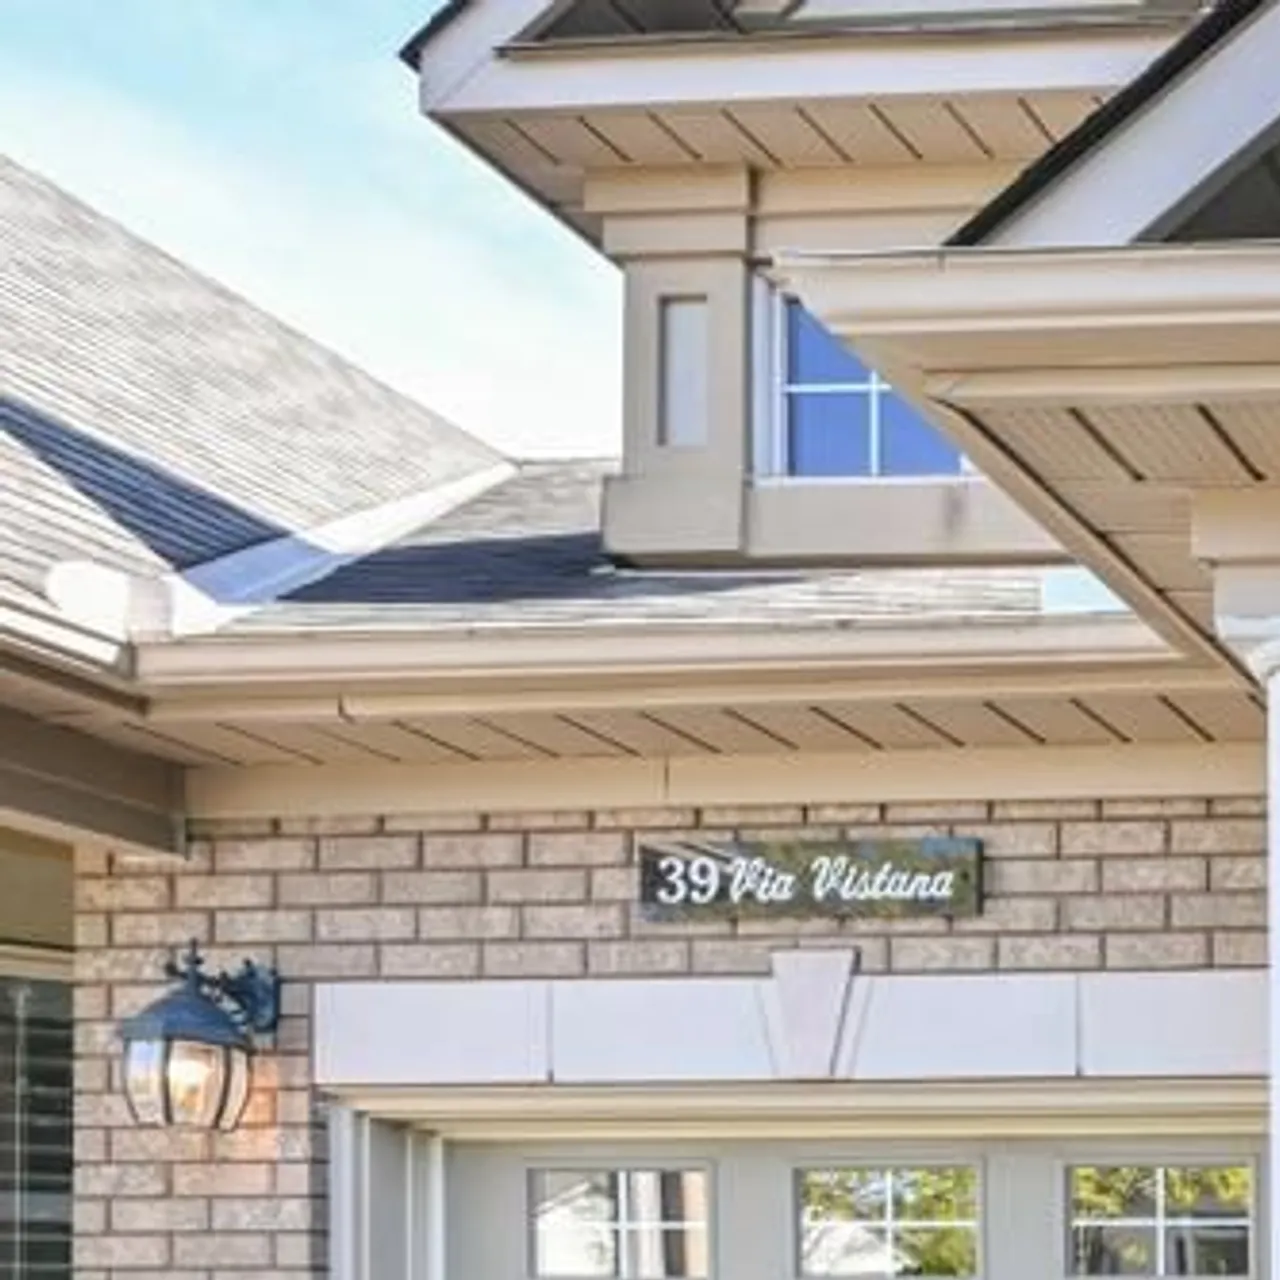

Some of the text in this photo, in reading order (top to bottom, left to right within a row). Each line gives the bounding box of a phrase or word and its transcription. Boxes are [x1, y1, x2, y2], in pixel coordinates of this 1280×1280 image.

[656, 855, 955, 904] 39 Via Vistana
